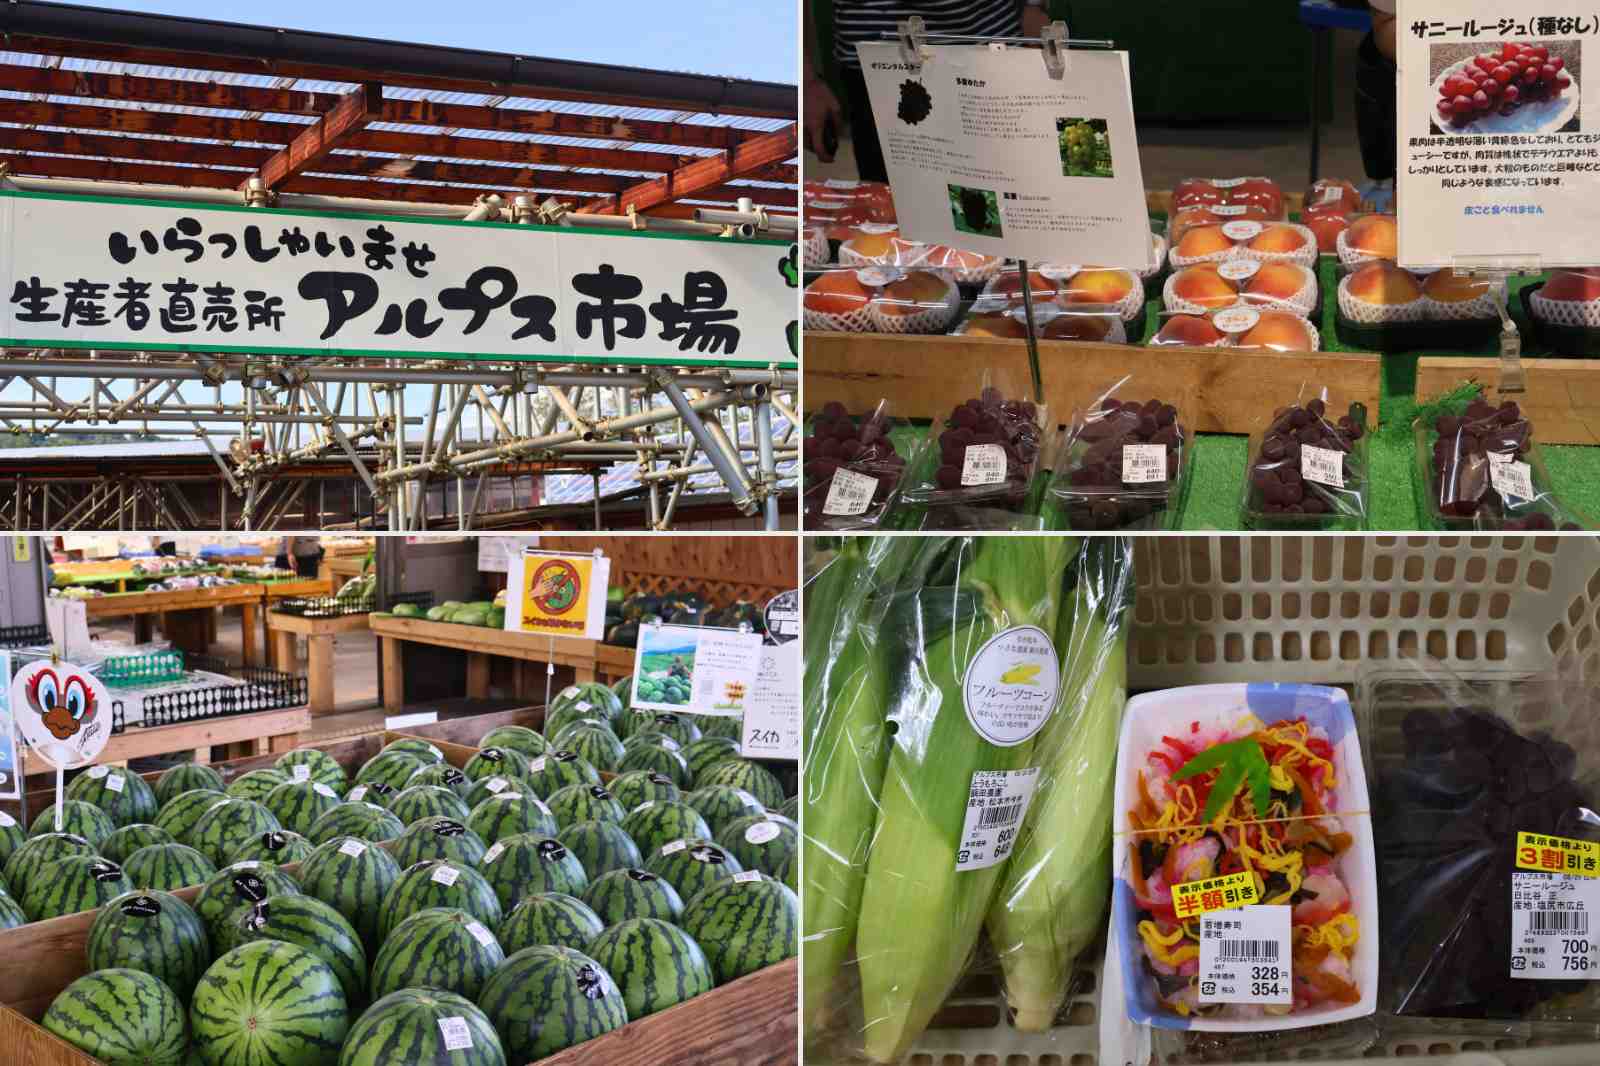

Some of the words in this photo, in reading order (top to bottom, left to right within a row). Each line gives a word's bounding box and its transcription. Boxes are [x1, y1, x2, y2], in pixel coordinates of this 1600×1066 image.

[109, 217, 436, 278] いらっしゃいませ
[10, 276, 286, 333] 生産者直売所
[298, 264, 740, 355] アルプス市場
[750, 729, 780, 745] スイカ
[1525, 834, 1592, 852] 表示価格より
[1520, 847, 1597, 871] 3割引き
[1179, 874, 1246, 894] 表示価格より
[1514, 882, 1575, 891] サニールージュ
[1178, 885, 1253, 914] 半額引き
